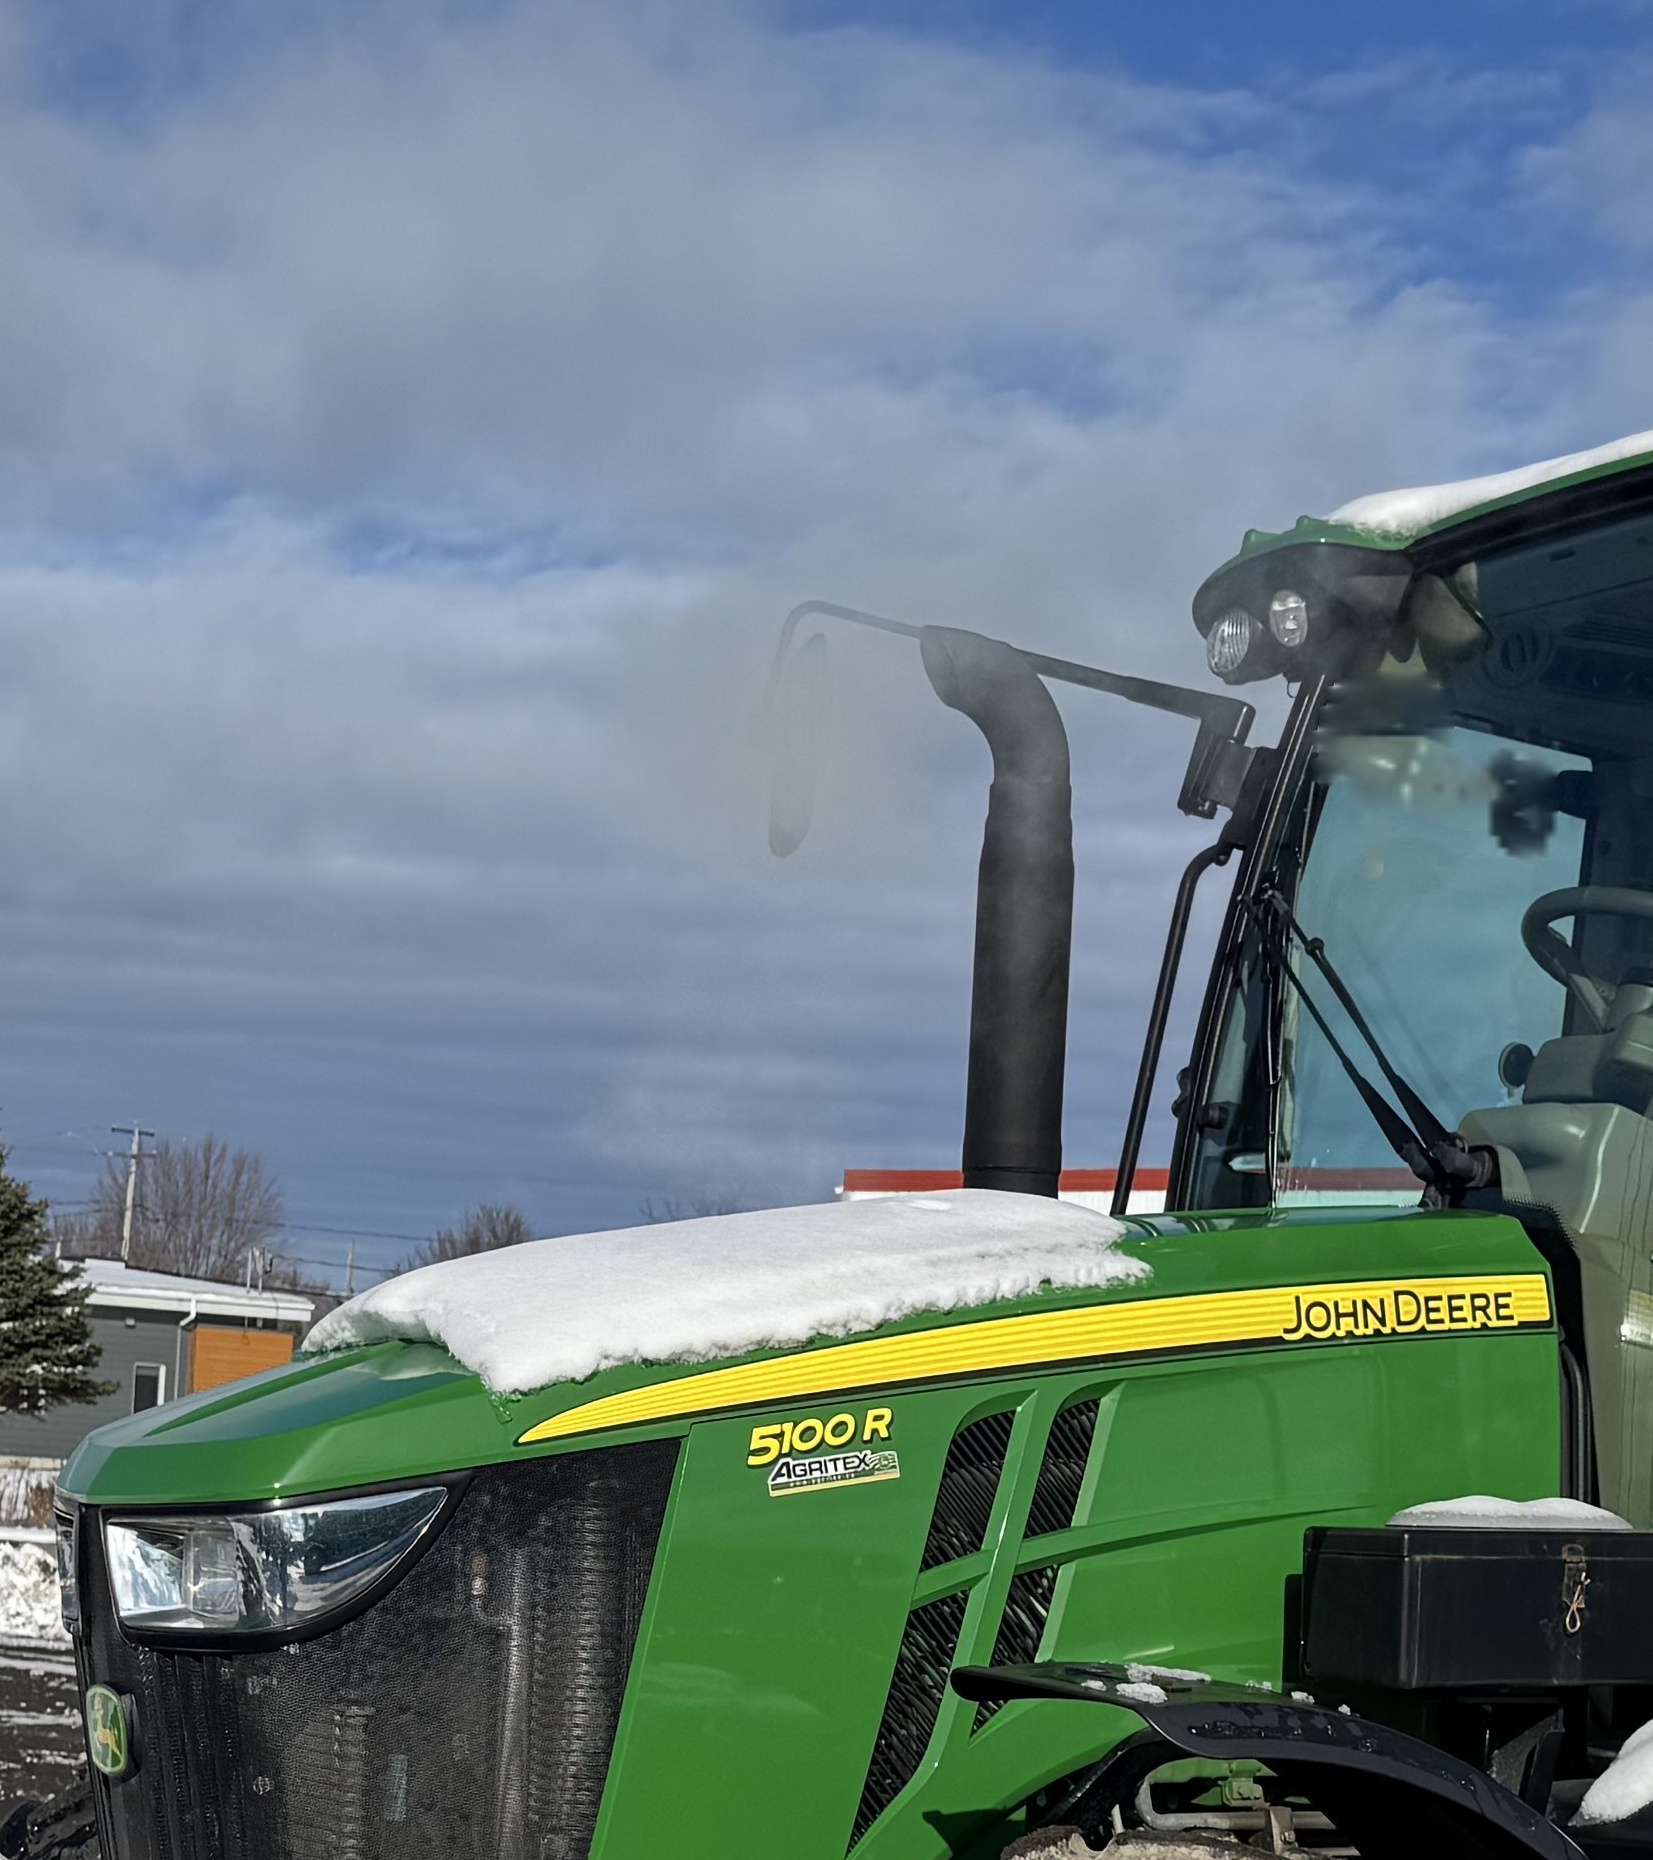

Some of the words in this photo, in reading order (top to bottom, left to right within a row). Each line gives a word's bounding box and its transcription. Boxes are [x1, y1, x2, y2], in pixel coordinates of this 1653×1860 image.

[1282, 1295, 1387, 1335] JOHN
[1393, 1290, 1514, 1326] DEERE
[747, 1412, 857, 1467] 5100
[863, 1408, 893, 1442] R
[771, 1454, 870, 1482] AGRITEX
